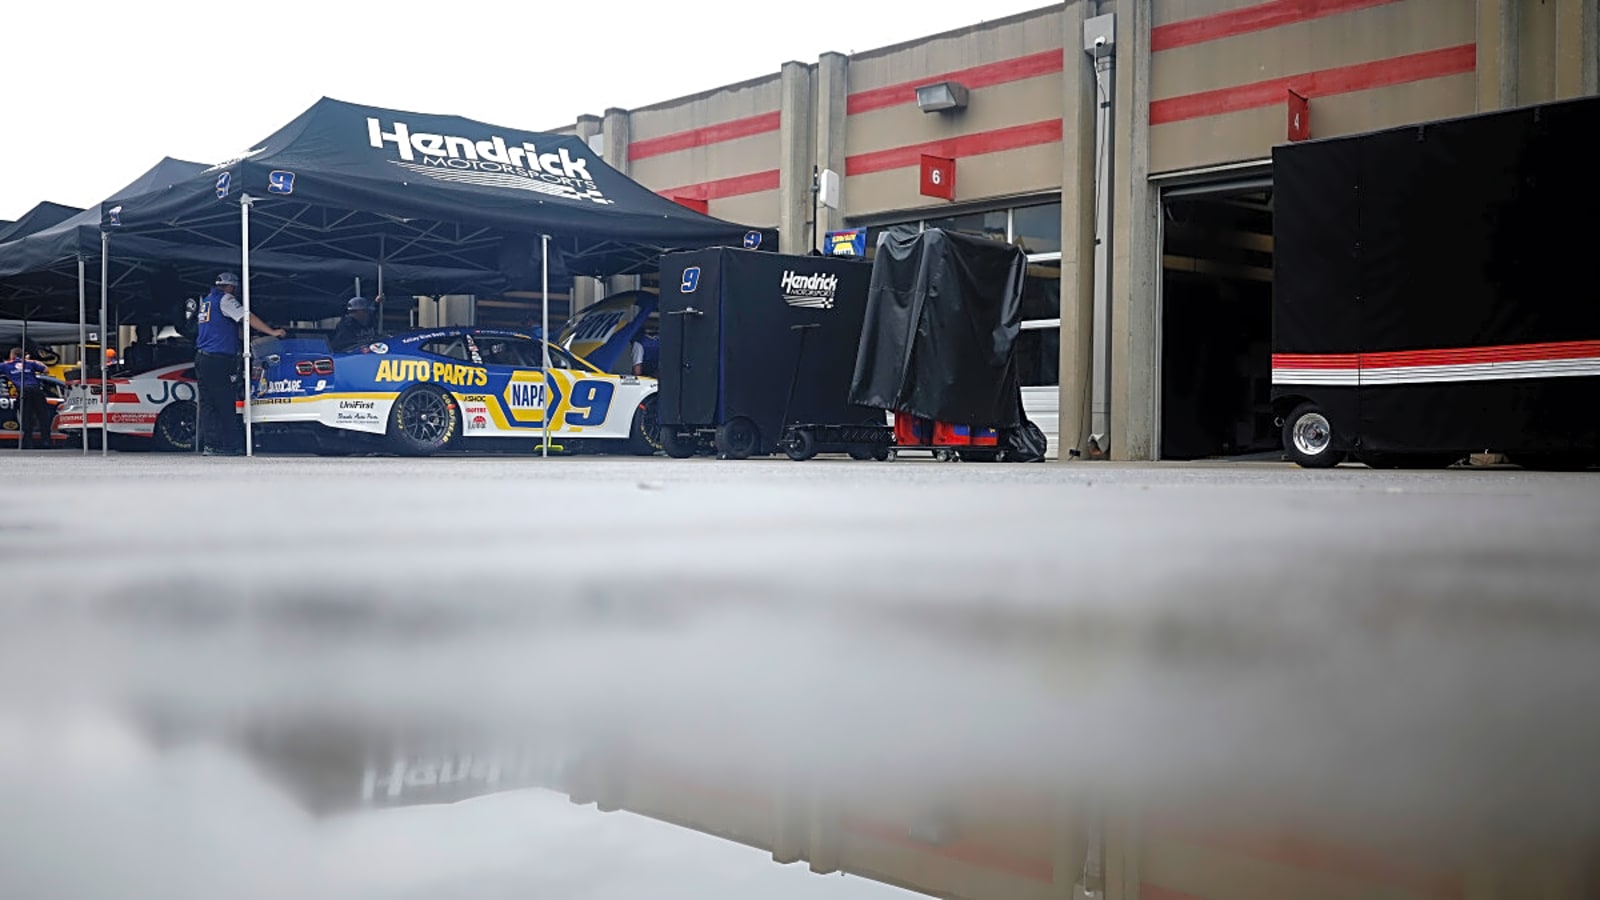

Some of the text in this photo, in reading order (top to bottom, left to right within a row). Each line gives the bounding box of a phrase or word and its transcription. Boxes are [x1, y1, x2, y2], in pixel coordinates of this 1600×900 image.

[366, 117, 594, 181] Hendrick
[268, 170, 295, 194] 9
[423, 155, 598, 190] MOTORSPORTS
[931, 169, 941, 185] 6
[744, 230, 762, 250] 9
[681, 266, 701, 293] 9
[781, 270, 838, 294] Hendrick
[375, 359, 488, 386] AUTO PARTS
[315, 380, 327, 391] 9
[512, 384, 545, 407] NAPA
[339, 400, 374, 409] UniFirst
[564, 379, 616, 427] 9
